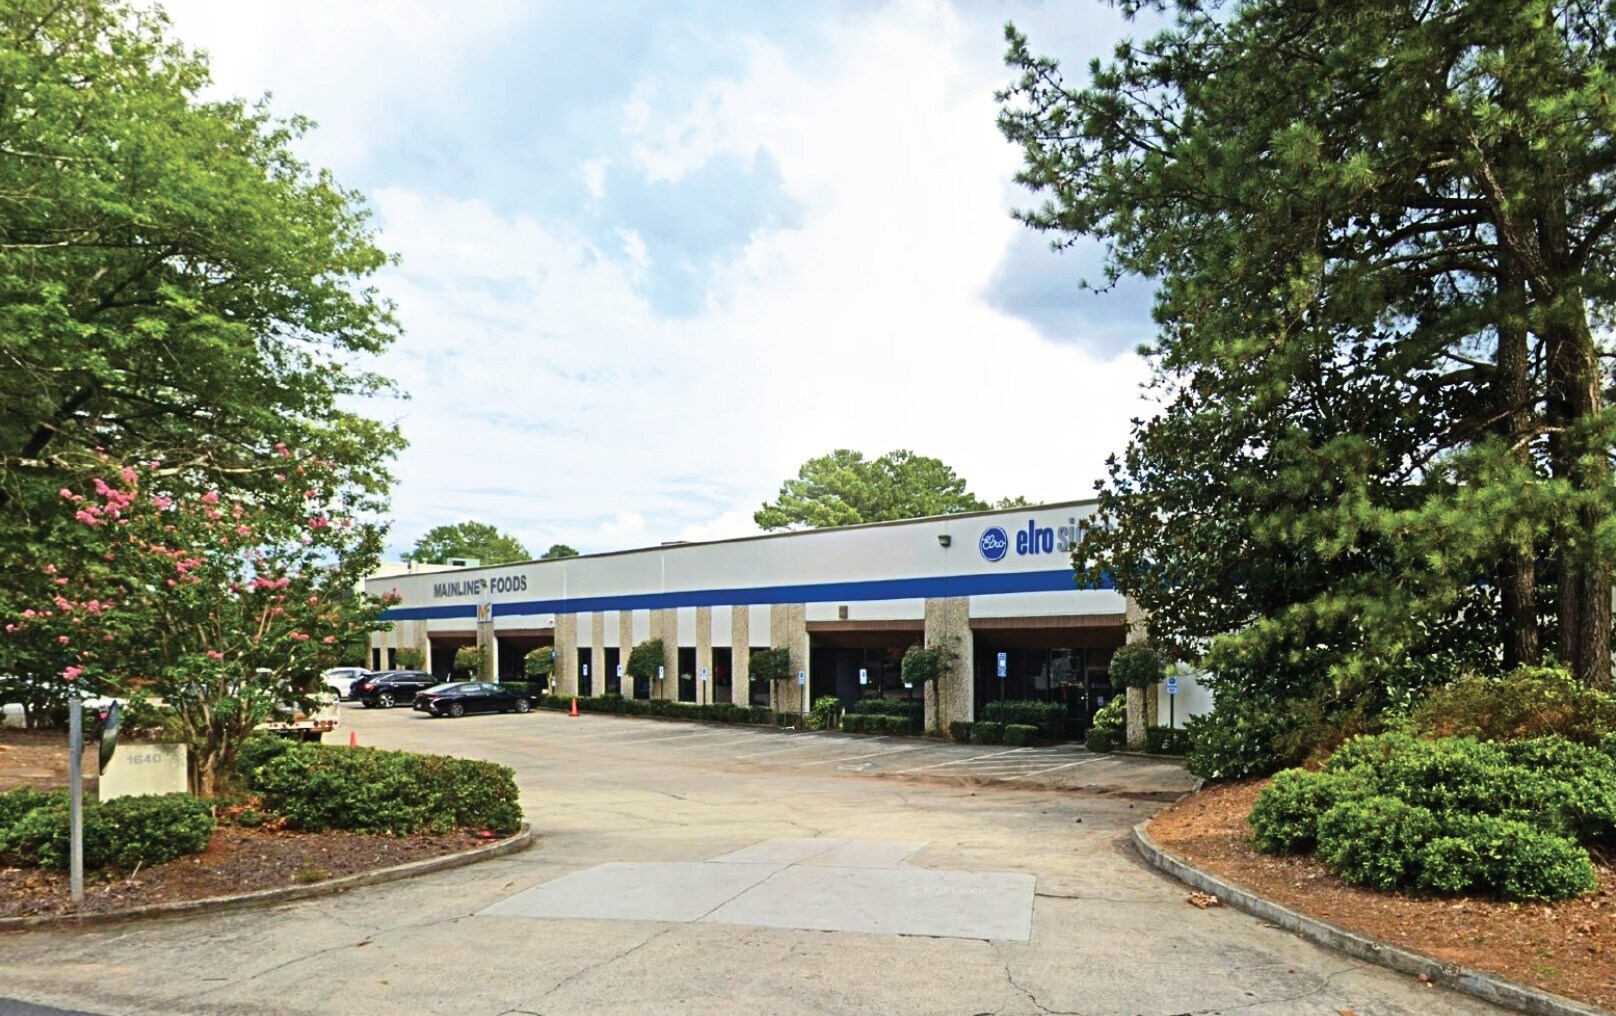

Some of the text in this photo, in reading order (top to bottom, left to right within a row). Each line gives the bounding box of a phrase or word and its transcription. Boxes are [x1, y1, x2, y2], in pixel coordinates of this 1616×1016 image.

[1016, 519, 1054, 555] elro
[434, 575, 527, 597] MAINLINE FOODS
[128, 754, 162, 765] 1640
